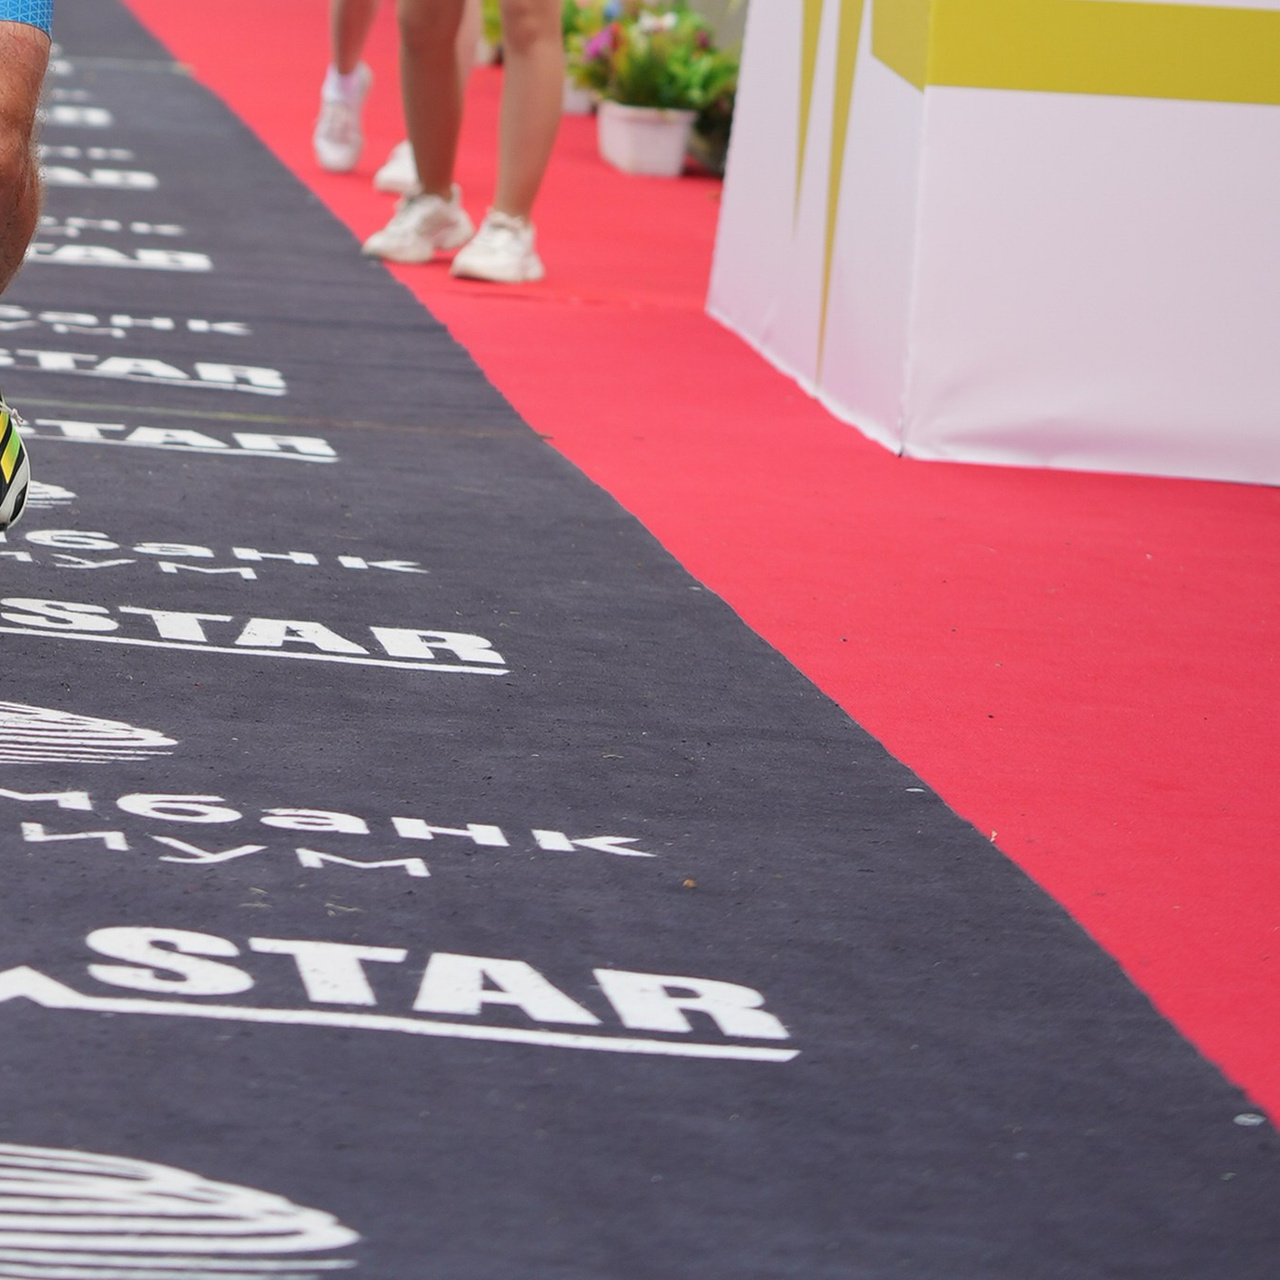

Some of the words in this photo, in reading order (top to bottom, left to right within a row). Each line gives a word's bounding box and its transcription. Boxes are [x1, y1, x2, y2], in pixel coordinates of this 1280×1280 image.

[16, 415, 338, 457] TAR
[0, 597, 507, 665] STAR
[85, 926, 791, 1040] STAR
